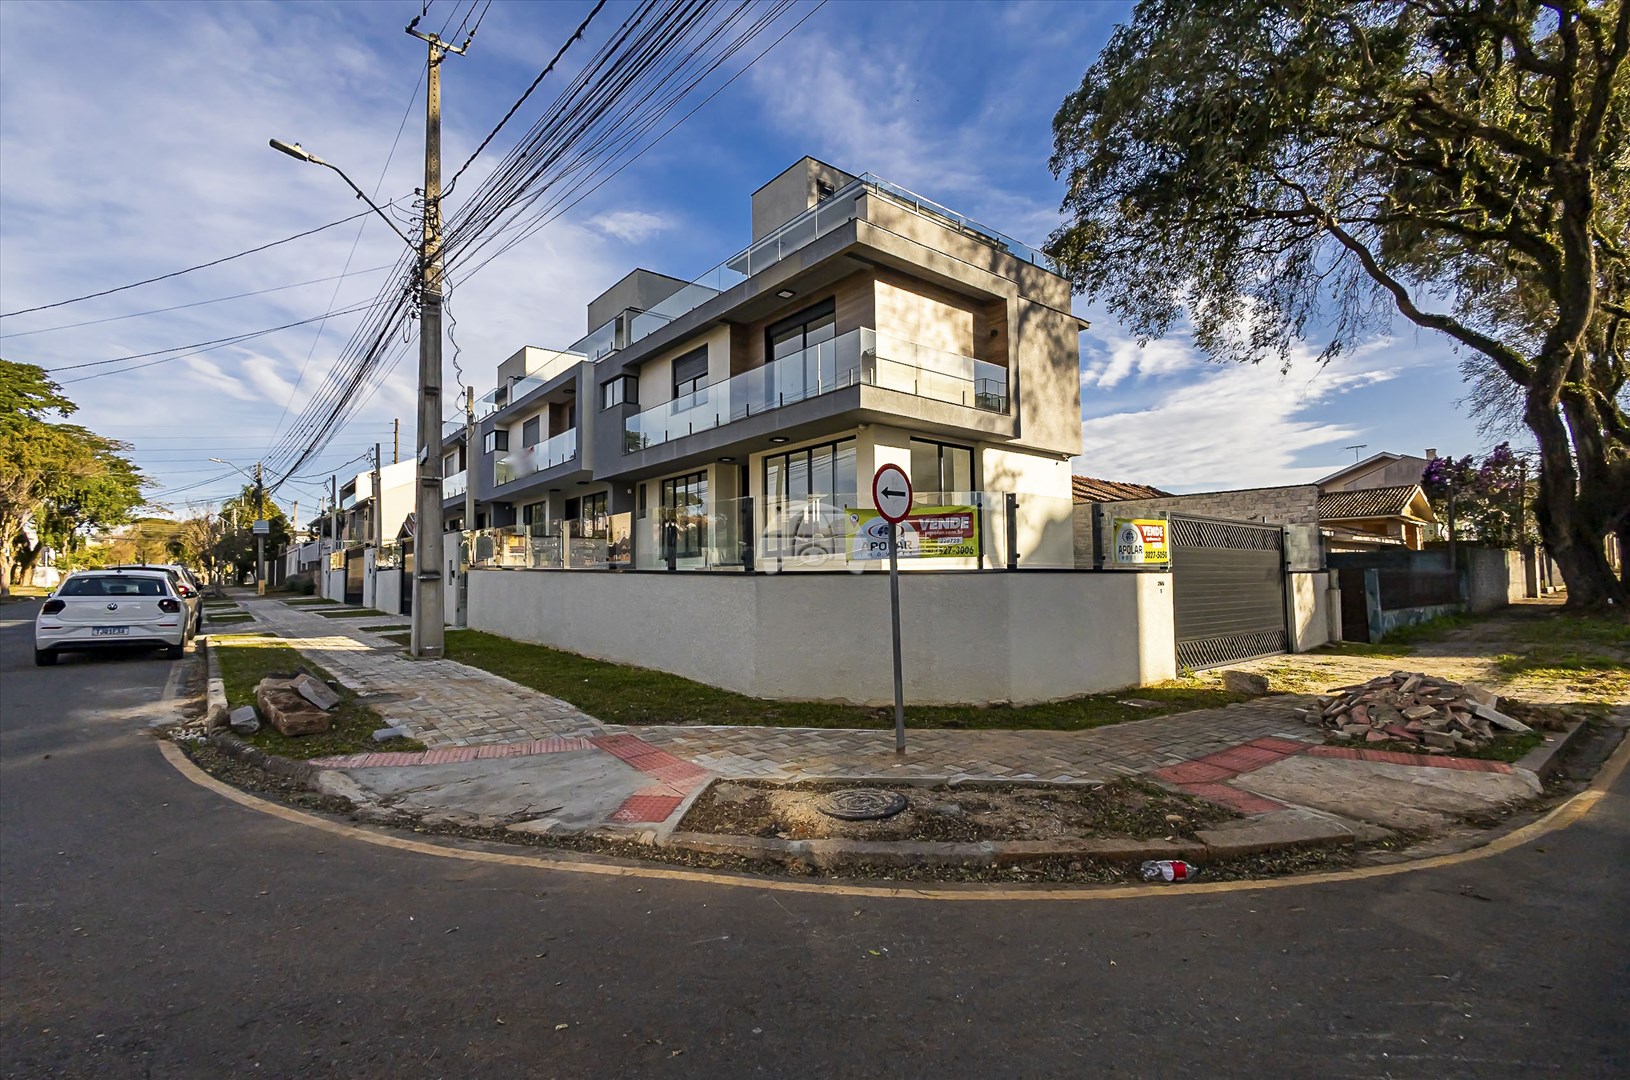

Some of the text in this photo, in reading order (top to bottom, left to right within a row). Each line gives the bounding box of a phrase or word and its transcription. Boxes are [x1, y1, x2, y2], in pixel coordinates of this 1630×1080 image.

[919, 516, 970, 531] VENDE
[1141, 526, 1164, 536] VENDE
[861, 540, 913, 551] APOAR
[1118, 544, 1142, 554] APOLAR
